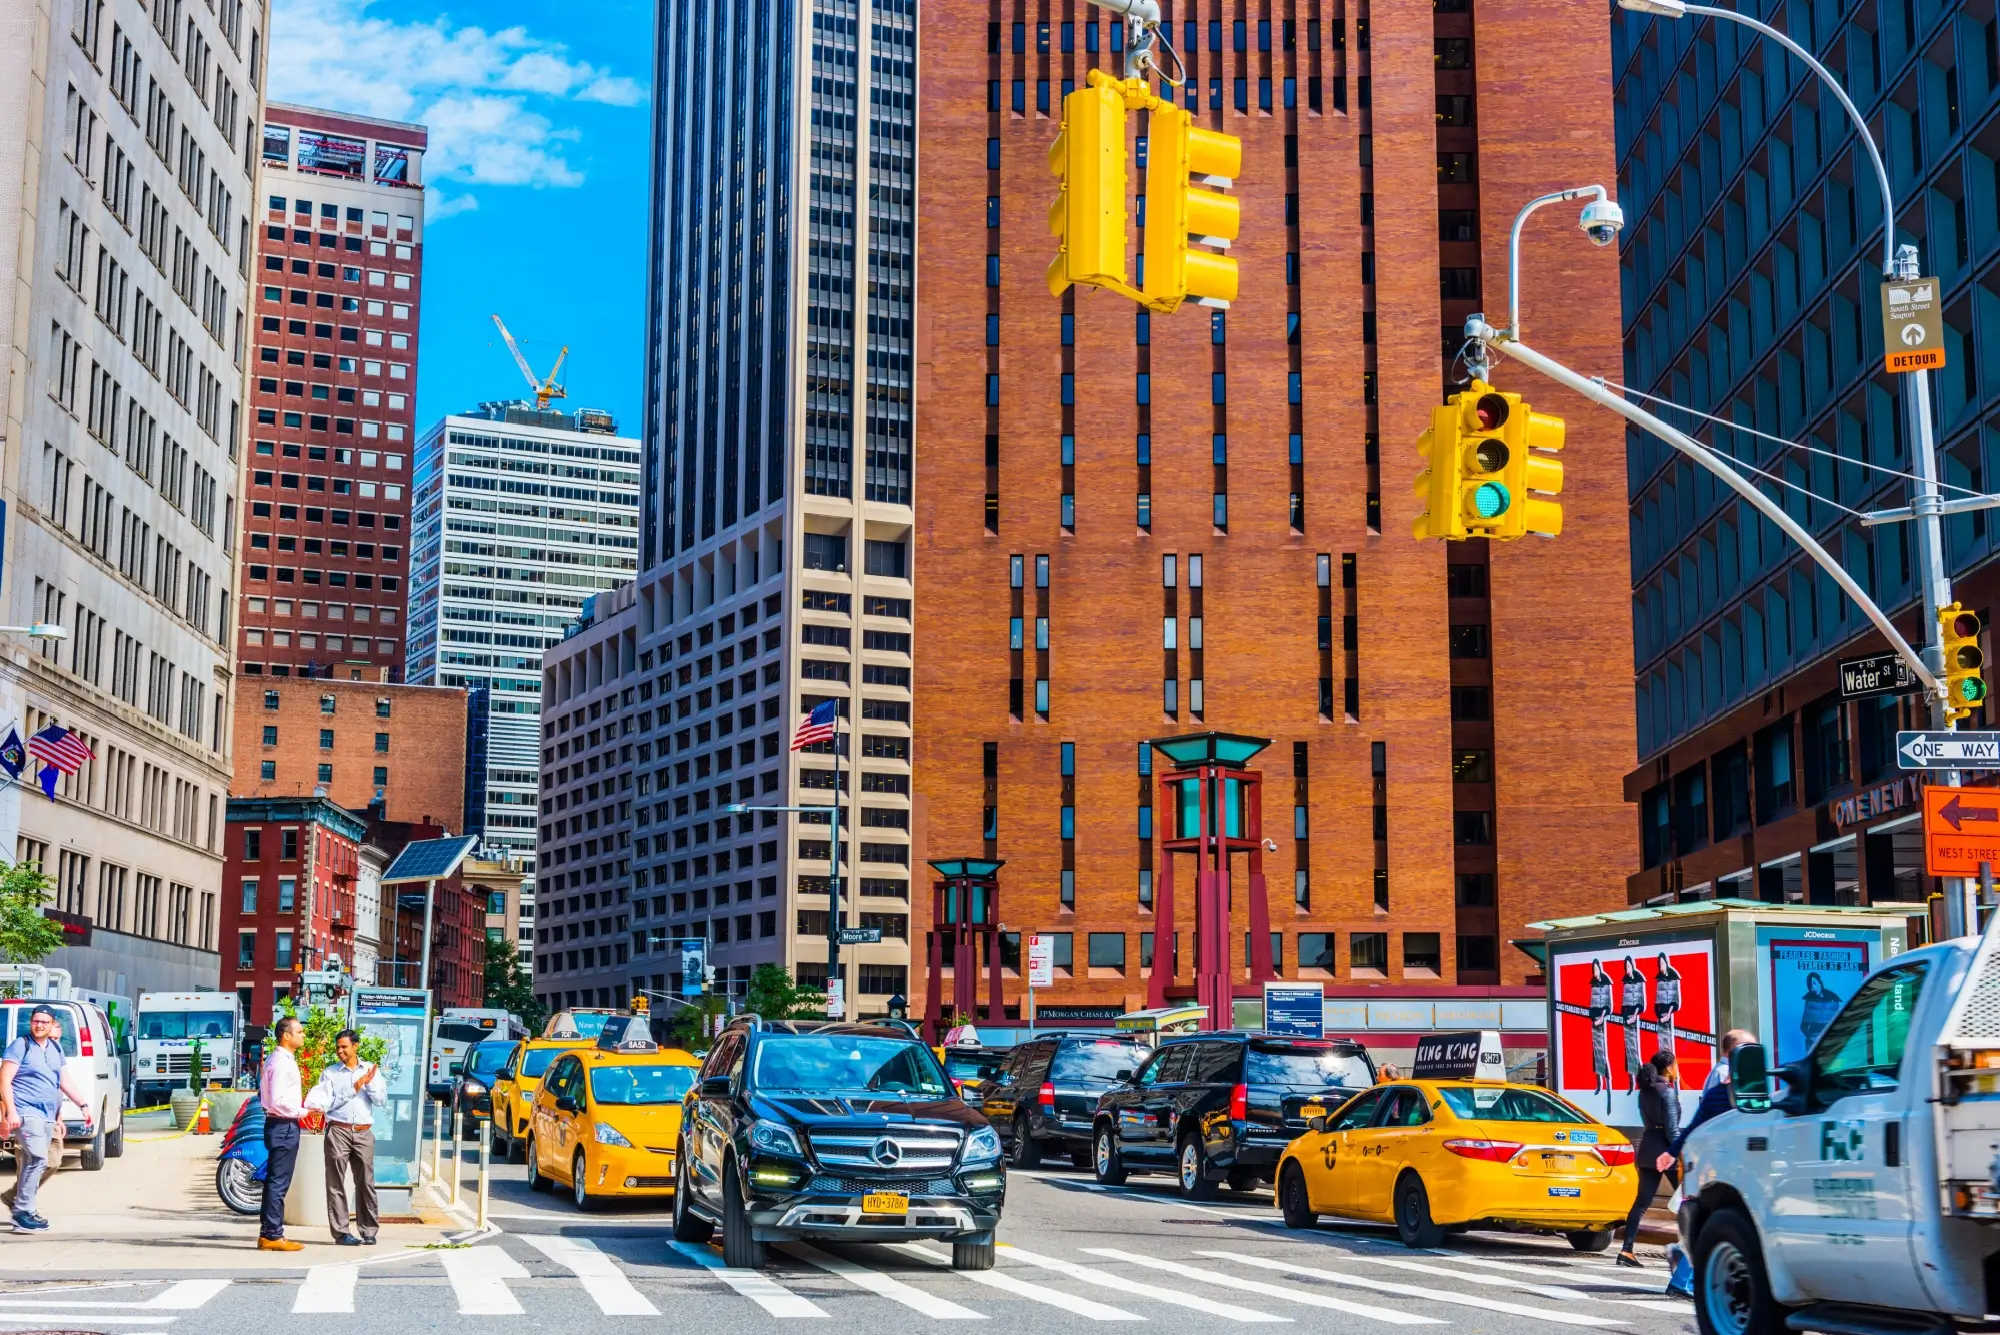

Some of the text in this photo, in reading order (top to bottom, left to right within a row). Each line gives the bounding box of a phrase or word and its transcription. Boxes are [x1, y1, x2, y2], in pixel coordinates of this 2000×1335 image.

[1890, 302, 1930, 313] South Street
[1890, 311, 1915, 320] Seaport
[1894, 353, 1937, 367] DETOUR
[1845, 670, 1880, 691] Water
[1883, 665, 1891, 676] St
[1912, 743, 1995, 757] ONE WAY
[1938, 847, 1964, 859] WEST
[843, 932, 863, 941] Moore
[1804, 931, 1836, 939] JCDecaux
[1780, 951, 1848, 961] FEARLESS FASHION
[1799, 961, 1859, 972] STARTS AT SAKS
[628, 1041, 646, 1049] 8A52
[1417, 1044, 1443, 1062] KING
[1484, 1053, 1499, 1063] 3H73
